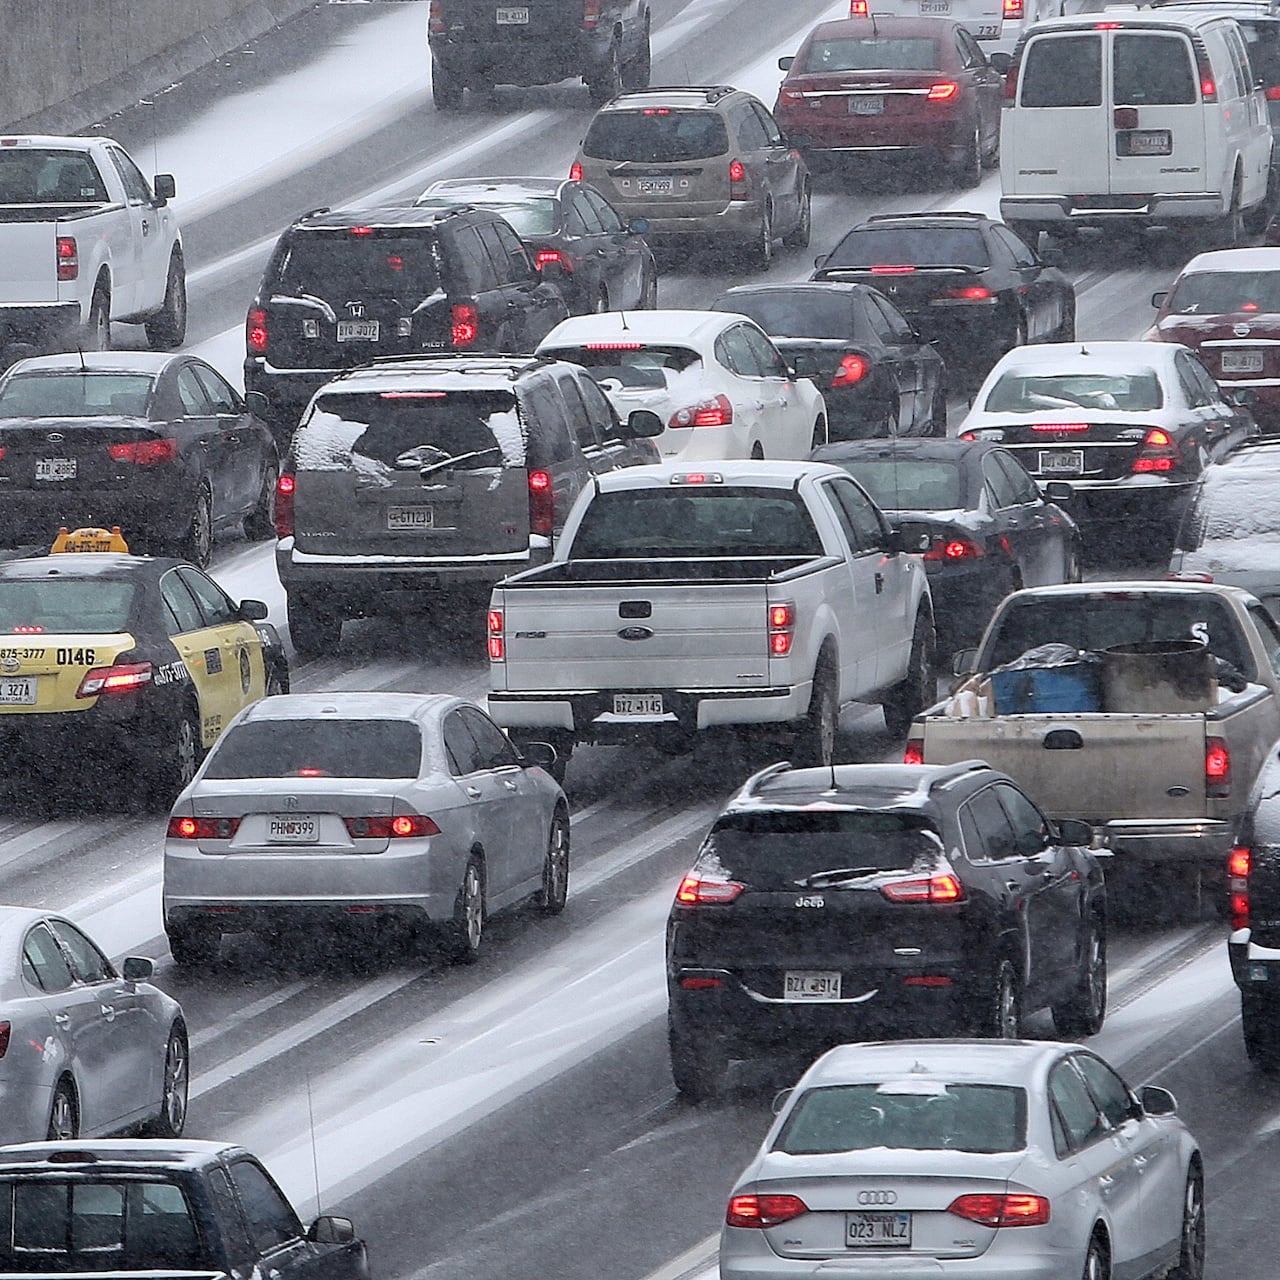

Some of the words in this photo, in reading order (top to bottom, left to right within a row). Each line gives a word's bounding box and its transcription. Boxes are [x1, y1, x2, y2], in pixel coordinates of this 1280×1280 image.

[979, 26, 999, 35] 727
[56, 647, 95, 666] 0146
[8, 683, 30, 696] 327A
[795, 897, 825, 910] Jeep
[849, 1223, 875, 1239] 023
[882, 1222, 908, 1238] NLZ
